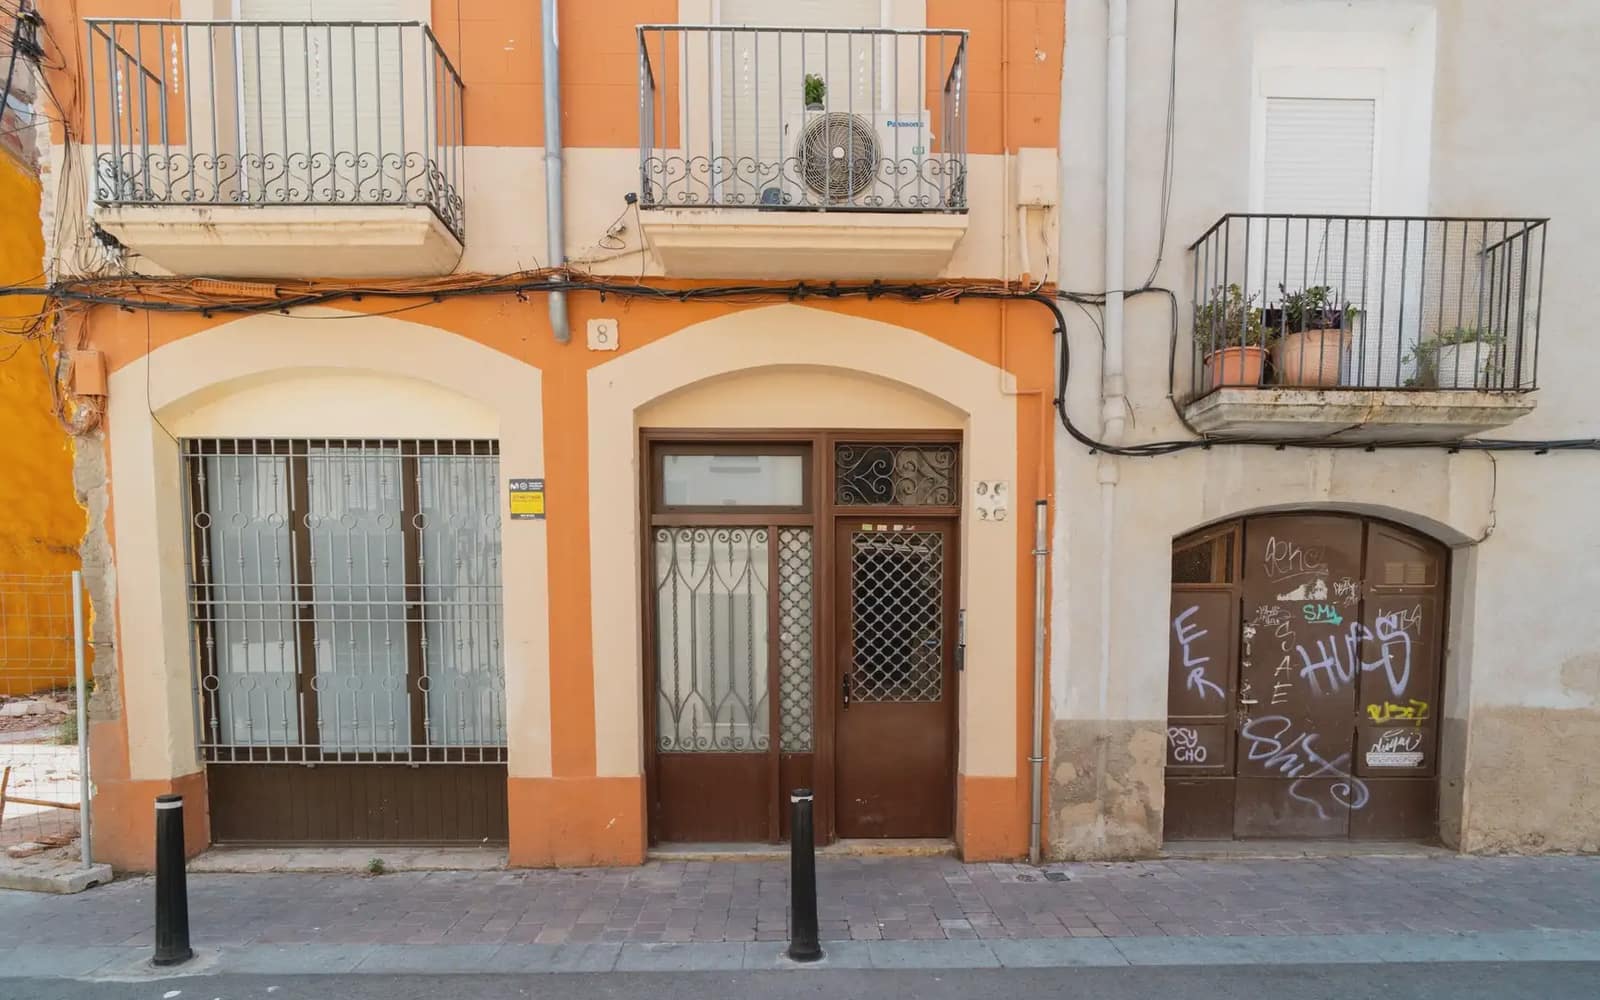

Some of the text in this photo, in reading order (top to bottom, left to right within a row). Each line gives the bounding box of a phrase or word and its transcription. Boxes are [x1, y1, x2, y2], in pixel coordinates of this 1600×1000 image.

[887, 120, 924, 128] Panasonc
[597, 324, 608, 344] 8
[1174, 746, 1207, 762] CHO
